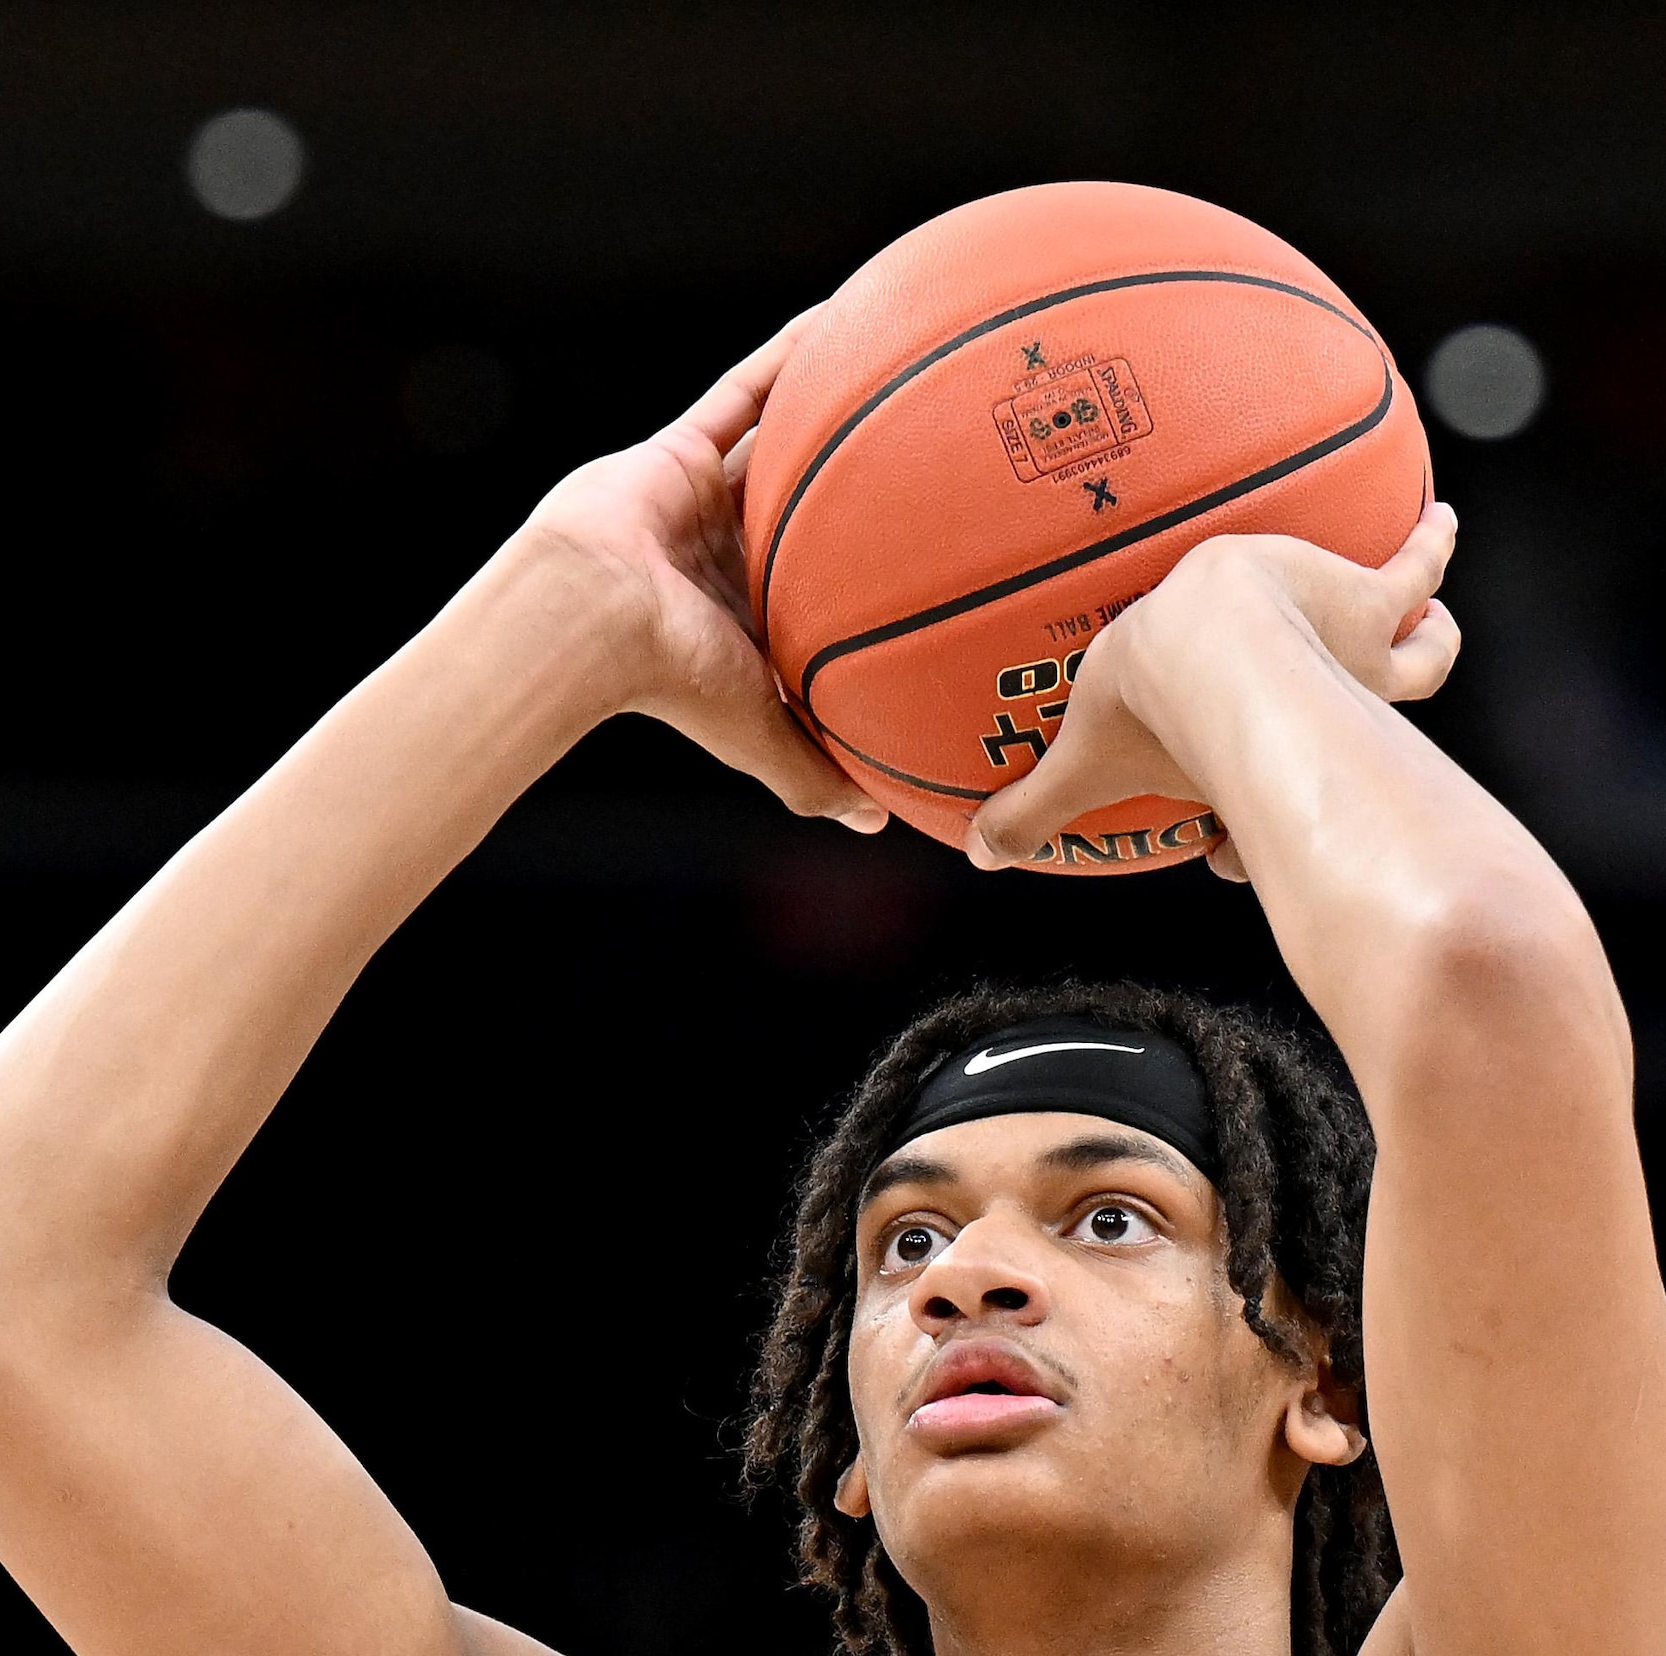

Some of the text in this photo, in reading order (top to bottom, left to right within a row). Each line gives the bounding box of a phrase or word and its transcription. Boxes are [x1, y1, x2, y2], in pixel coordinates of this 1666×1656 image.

[1047, 353, 1096, 380] INDOOR
[1098, 366, 1139, 435] SPALDING
[1001, 419, 1025, 455] SIZE
[1043, 593, 1147, 642] AME BALL
